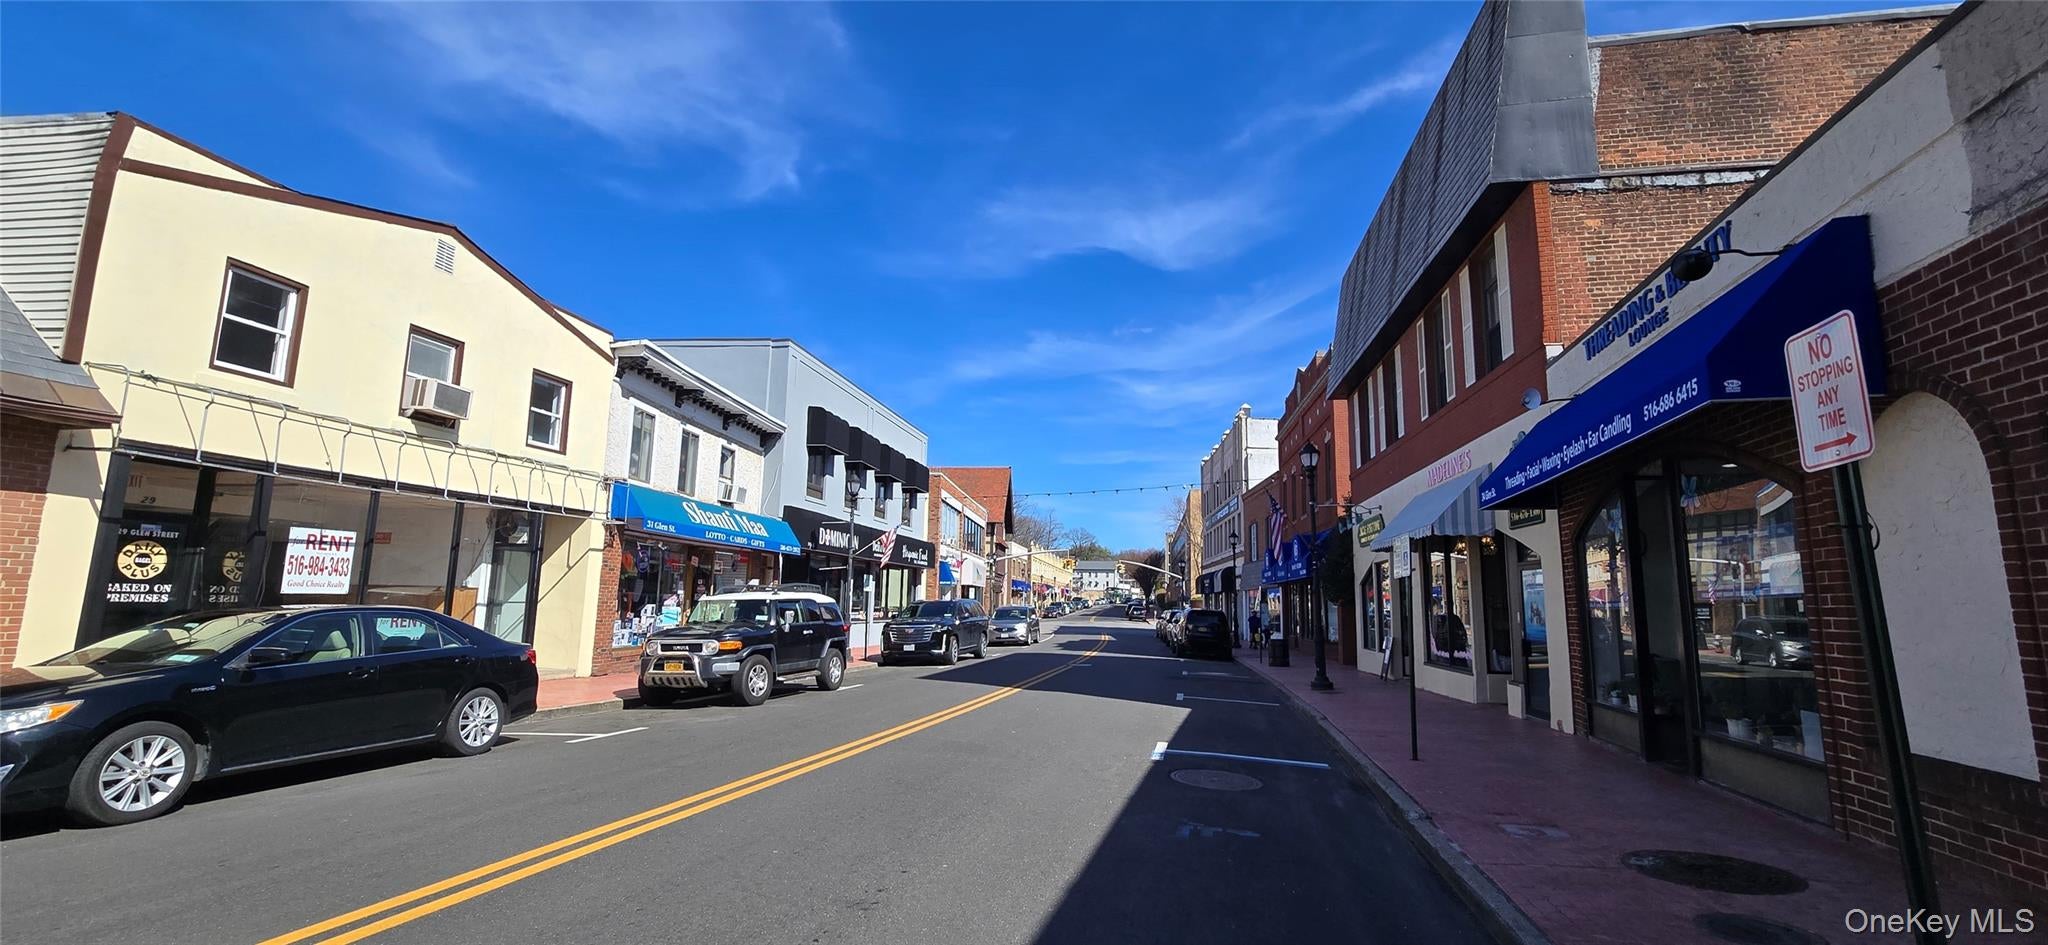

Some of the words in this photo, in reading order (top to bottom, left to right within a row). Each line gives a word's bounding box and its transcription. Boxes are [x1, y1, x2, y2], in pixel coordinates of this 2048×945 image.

[1583, 288, 1655, 361] THREADING
[1654, 284, 1667, 304] &
[1664, 220, 1733, 299] BTY
[1628, 305, 1670, 347] LOUNGE
[1807, 333, 1832, 365] NO
[1797, 356, 1854, 393] STOPPING
[1817, 385, 1839, 409] ANY
[1818, 407, 1847, 432] TIME
[1505, 472, 1526, 491] Threading
[1526, 462, 1540, 480] Facial
[1541, 452, 1561, 472] Waxing
[1563, 435, 1586, 463] Eyelash
[1588, 430, 1599, 449] Ear
[1599, 412, 1632, 444] Candling
[1643, 389, 1675, 422] 516-686
[1675, 377, 1698, 405] 6415
[1427, 449, 1472, 487] MADELINE'S
[128, 475, 143, 488] XIT
[141, 496, 156, 504] 29
[647, 520, 654, 528] 31
[654, 521, 668, 532] Glen
[682, 502, 739, 532] Shanti
[735, 513, 769, 538] Maa
[130, 529, 150, 537] GLEN
[152, 530, 180, 539] STREET
[305, 533, 354, 552] RENT
[705, 531, 726, 541] LOTTO
[730, 535, 748, 545] CARDS
[750, 538, 765, 548] GIFTS
[123, 542, 166, 558] DAILY
[122, 563, 160, 578] PLUS
[287, 554, 350, 577] 516-984-3433
[153, 583, 173, 593] ON
[287, 579, 304, 588] Good
[305, 580, 326, 588] Choice
[327, 581, 346, 589] Realty
